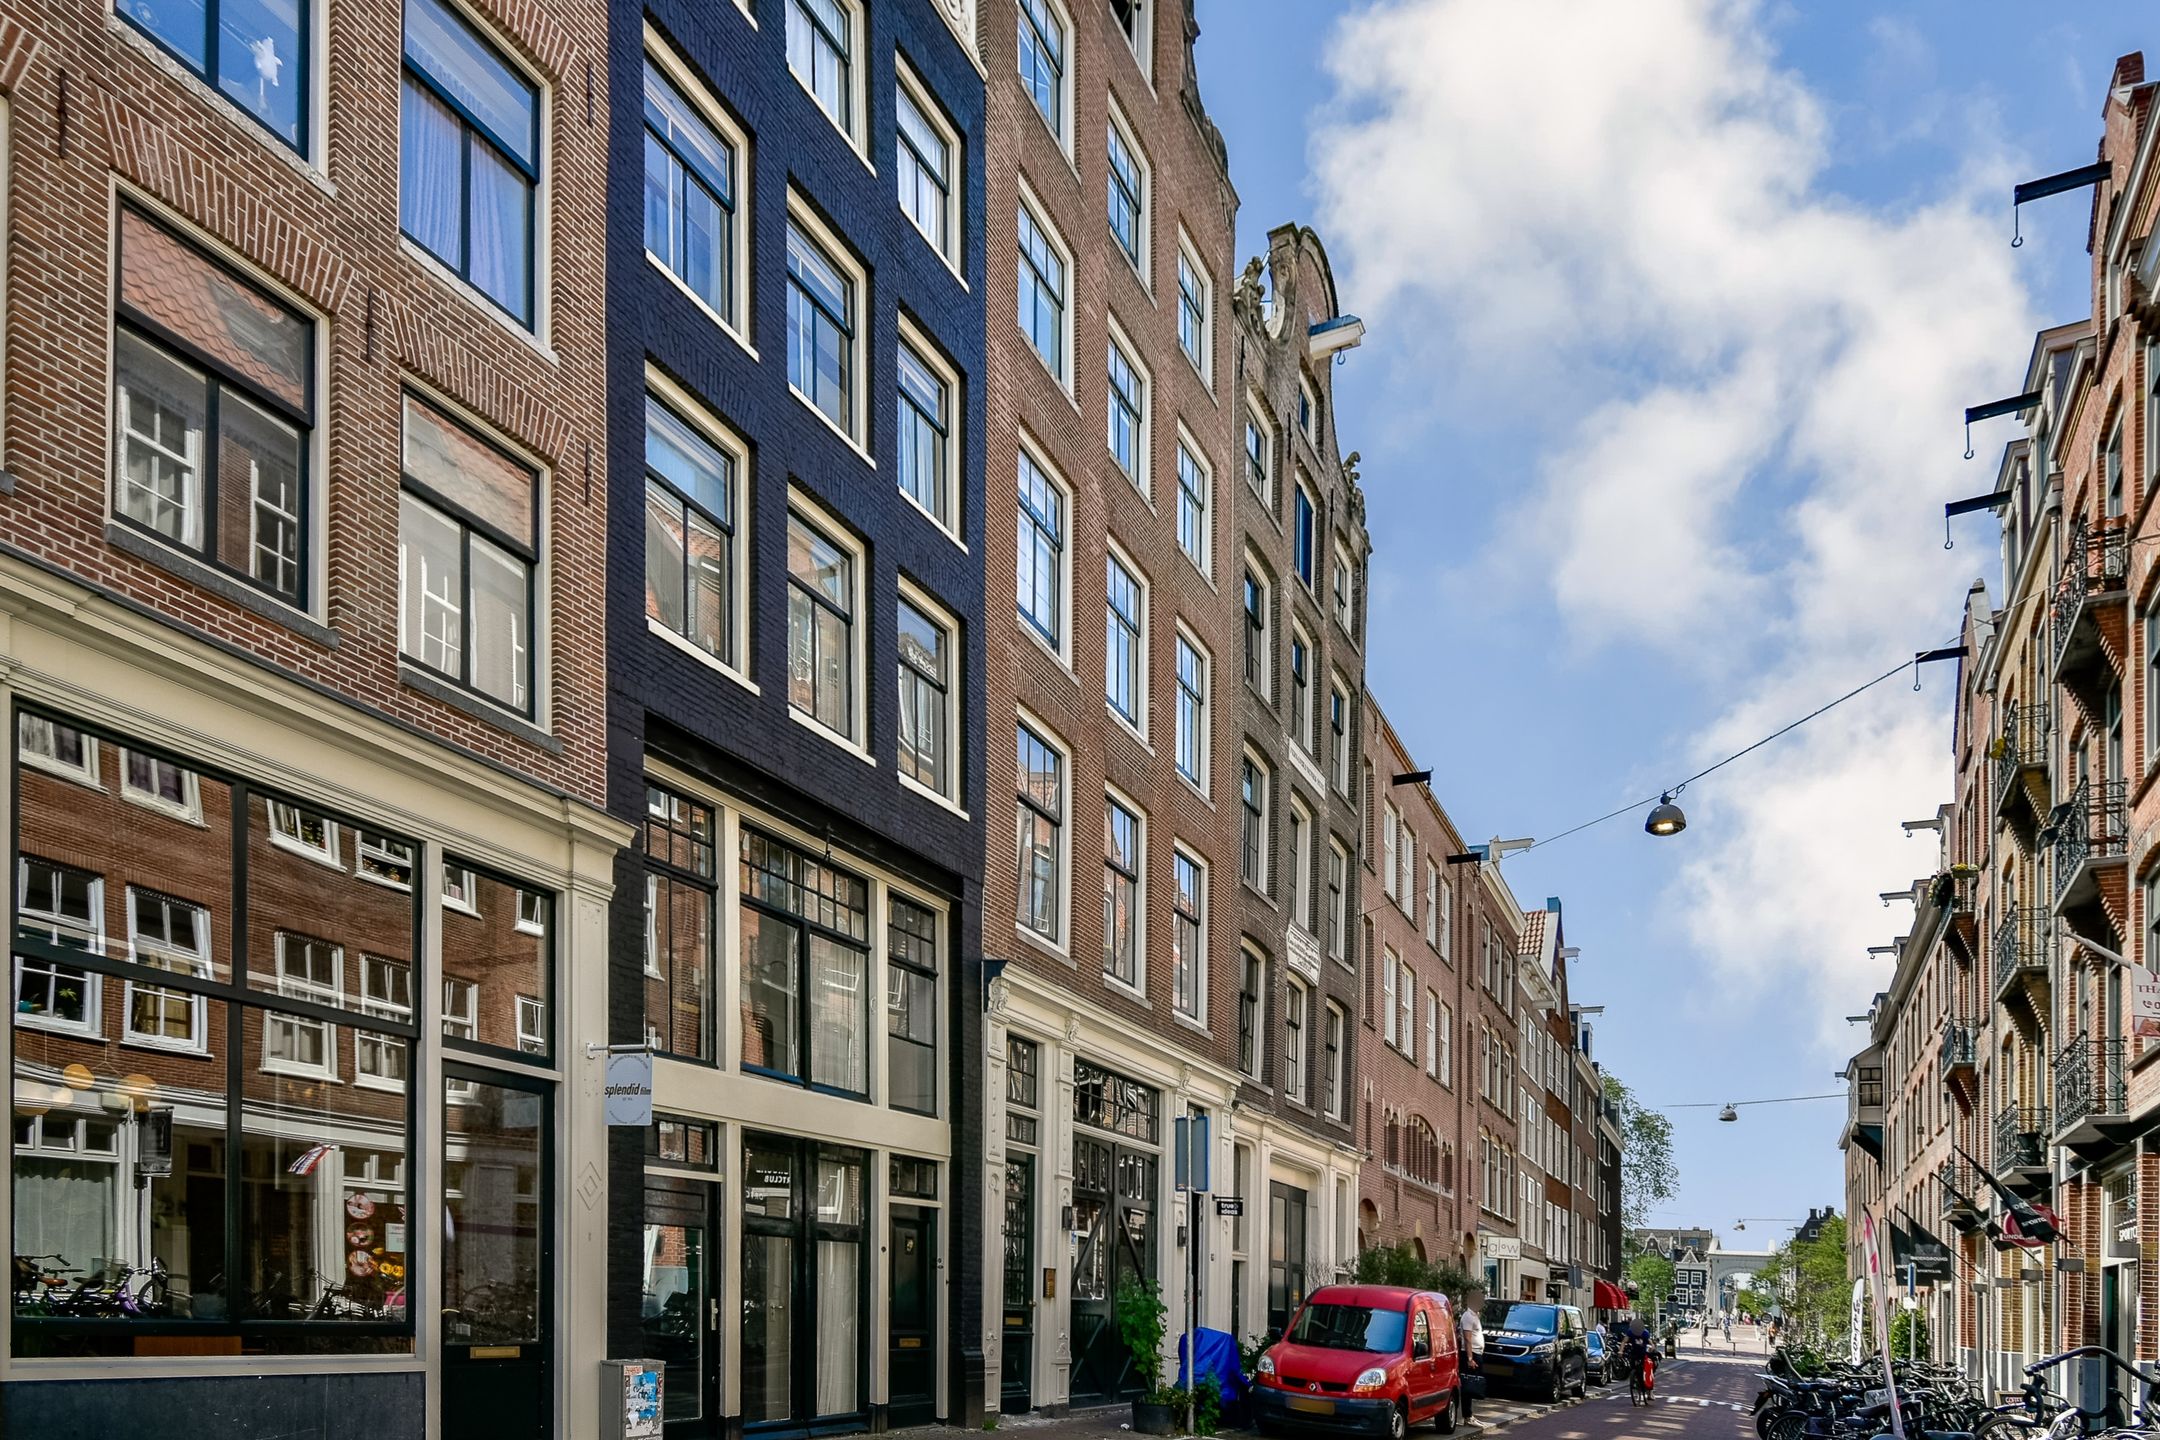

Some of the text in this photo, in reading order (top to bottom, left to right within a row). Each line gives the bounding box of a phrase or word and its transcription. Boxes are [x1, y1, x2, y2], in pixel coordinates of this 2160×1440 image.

[2136, 985, 2160, 994] TH
[604, 1083, 640, 1098] splendid
[1489, 1238, 1519, 1257] glow
